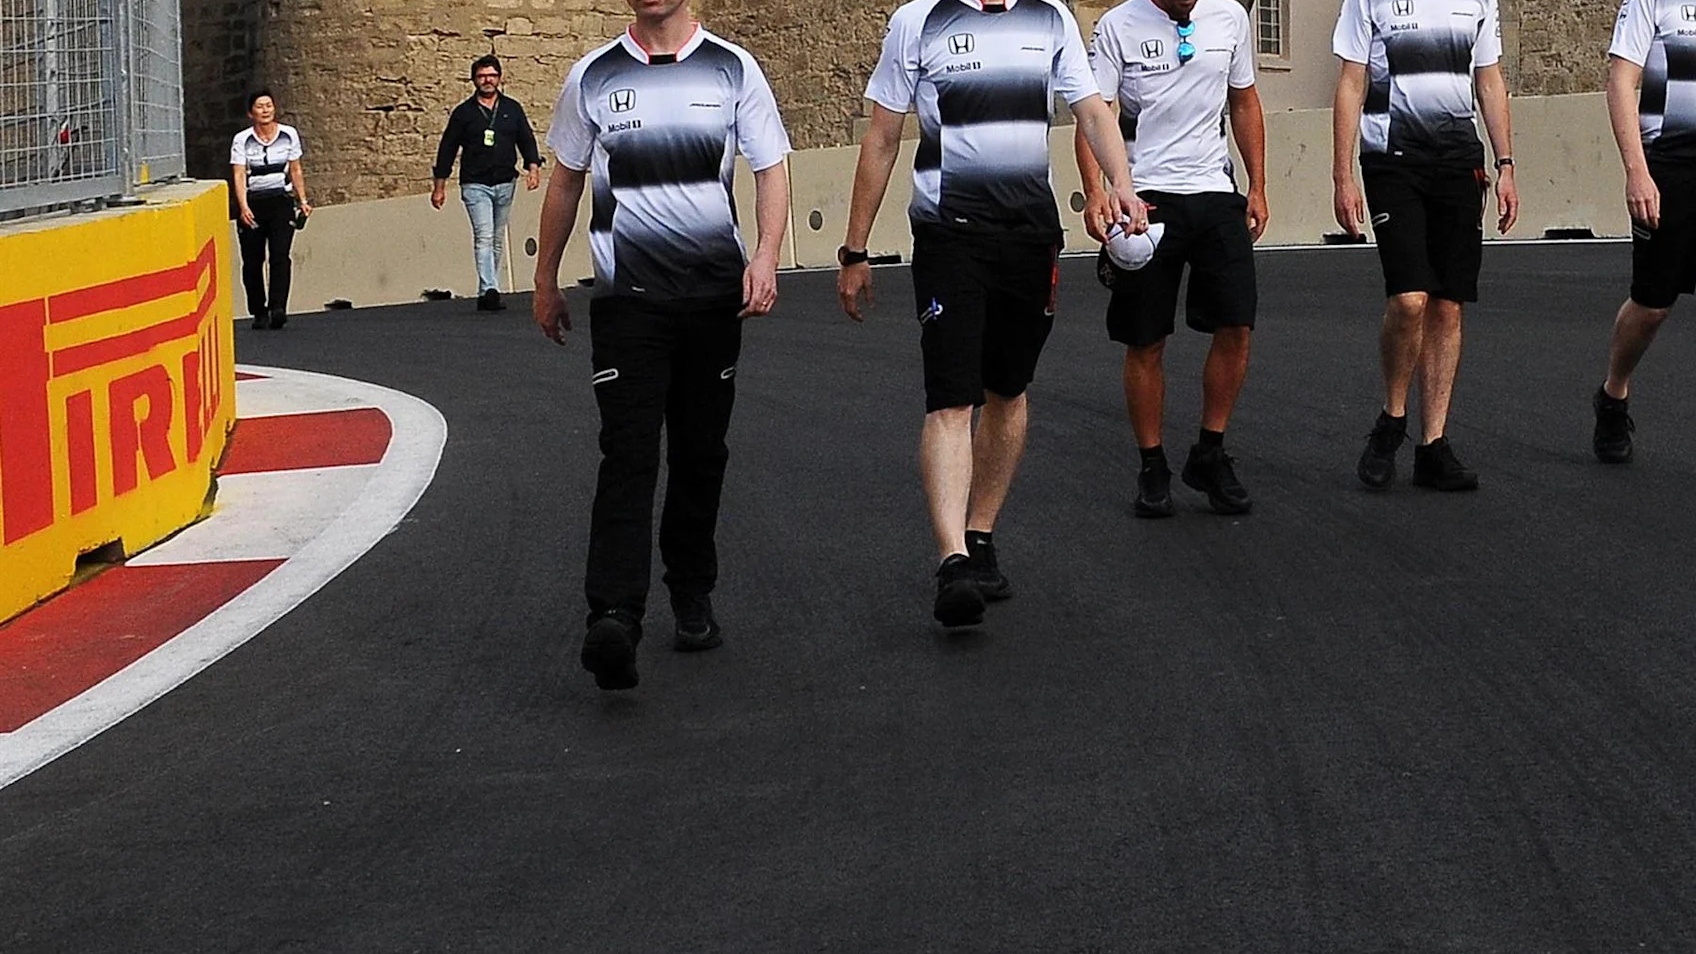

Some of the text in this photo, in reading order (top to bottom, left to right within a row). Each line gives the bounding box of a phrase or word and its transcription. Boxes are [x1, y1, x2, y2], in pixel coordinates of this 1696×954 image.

[1390, 23, 1411, 31] Mobil
[946, 62, 971, 73] Mobil
[608, 119, 631, 133] Mobil
